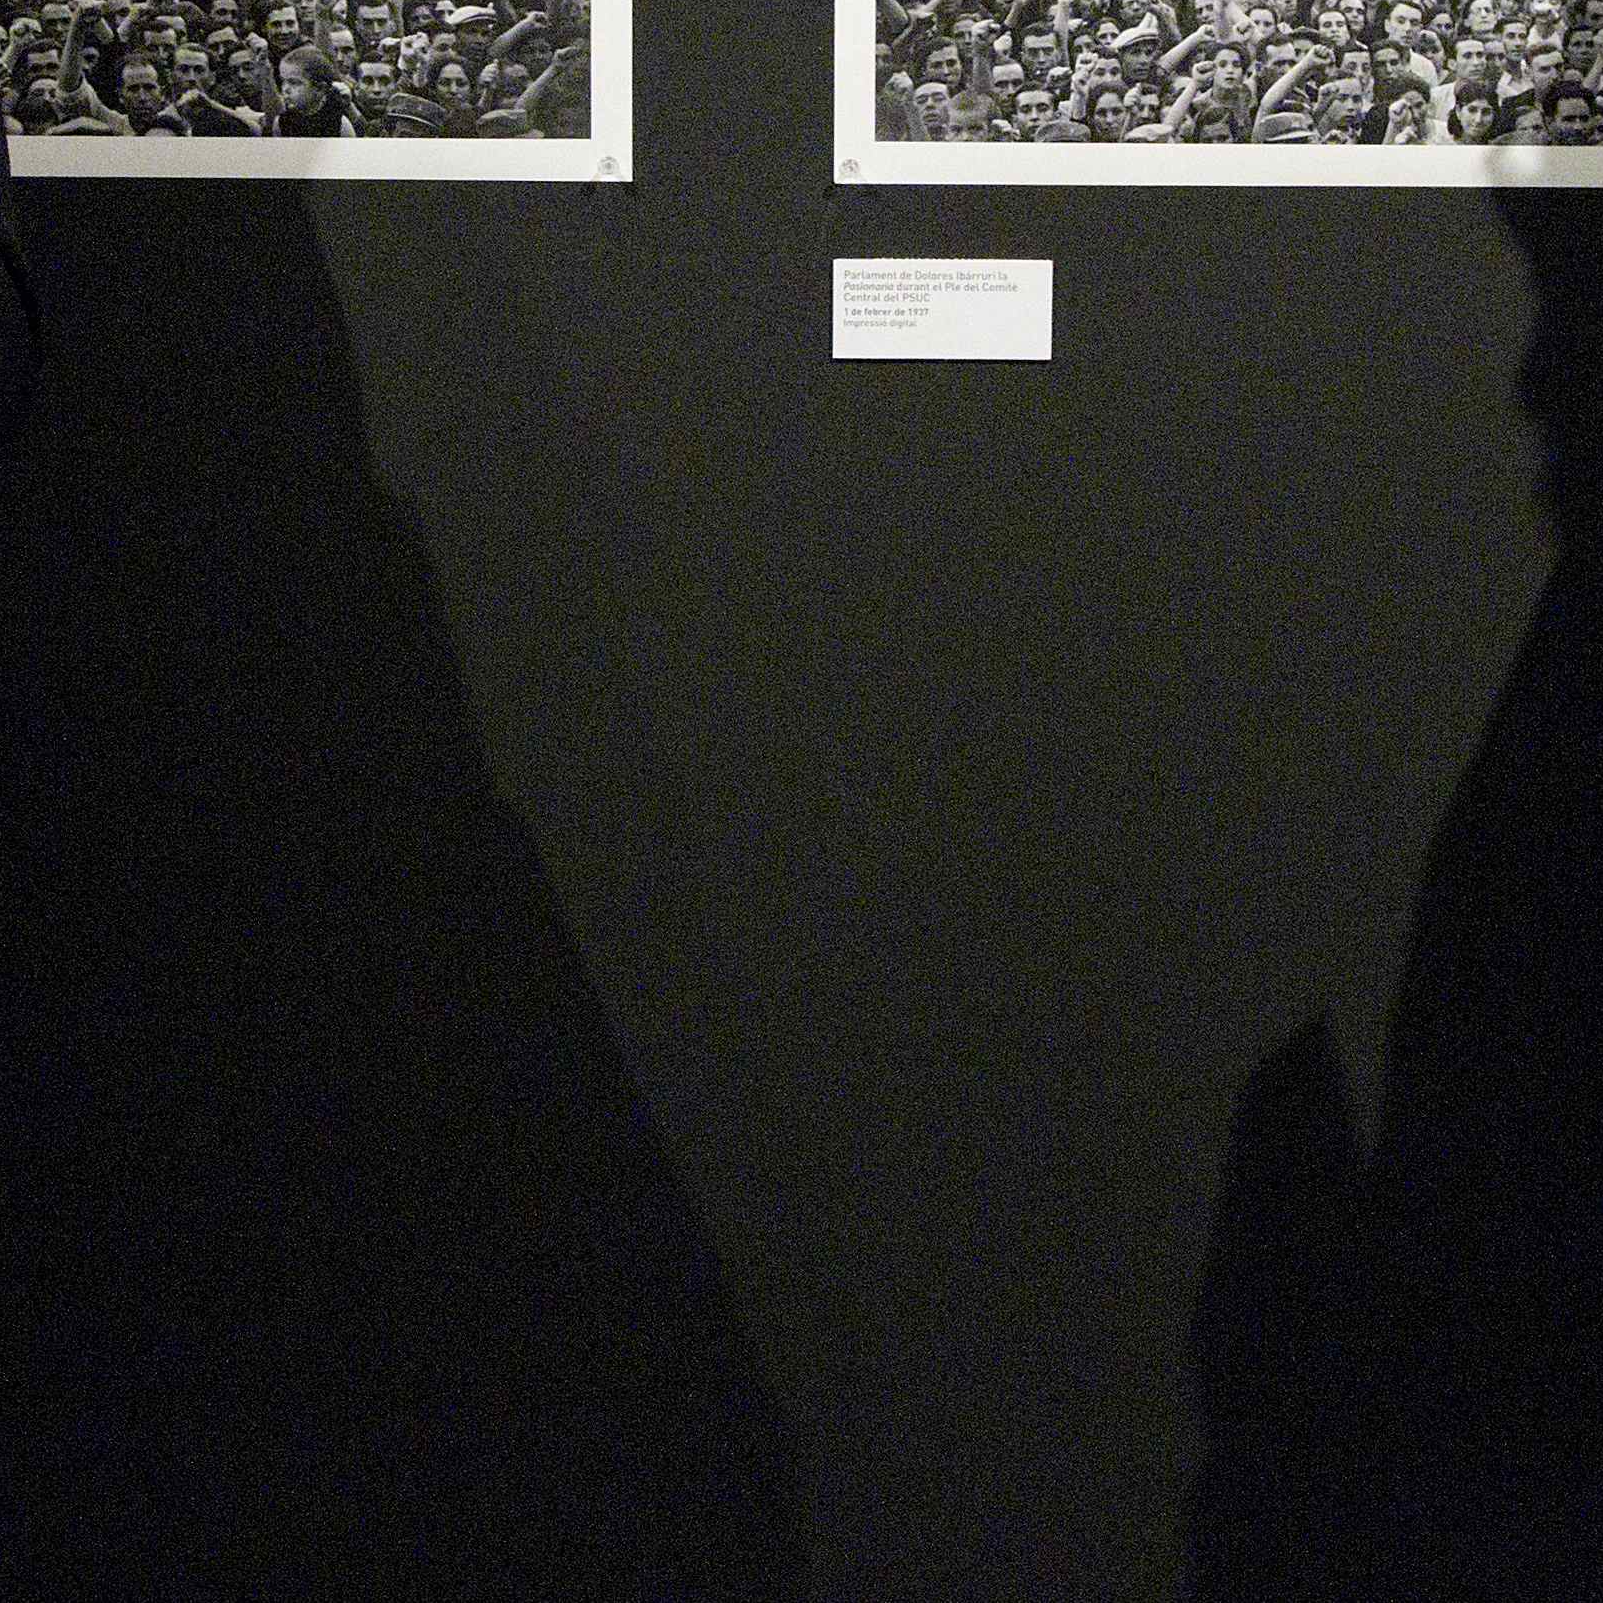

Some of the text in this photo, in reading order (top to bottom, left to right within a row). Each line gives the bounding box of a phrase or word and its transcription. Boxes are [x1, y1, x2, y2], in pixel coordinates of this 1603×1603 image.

[844, 270, 897, 280] Parlament
[899, 270, 912, 280] de
[915, 270, 953, 280] Dolores
[998, 271, 1008, 280] la
[896, 282, 930, 291] durant
[932, 282, 942, 291] el
[964, 283, 979, 292] del
[843, 293, 931, 303] Central del PSUC
[851, 308, 862, 317] de
[863, 308, 892, 317] febrer
[894, 308, 905, 317] de
[890, 320, 917, 330] digital
